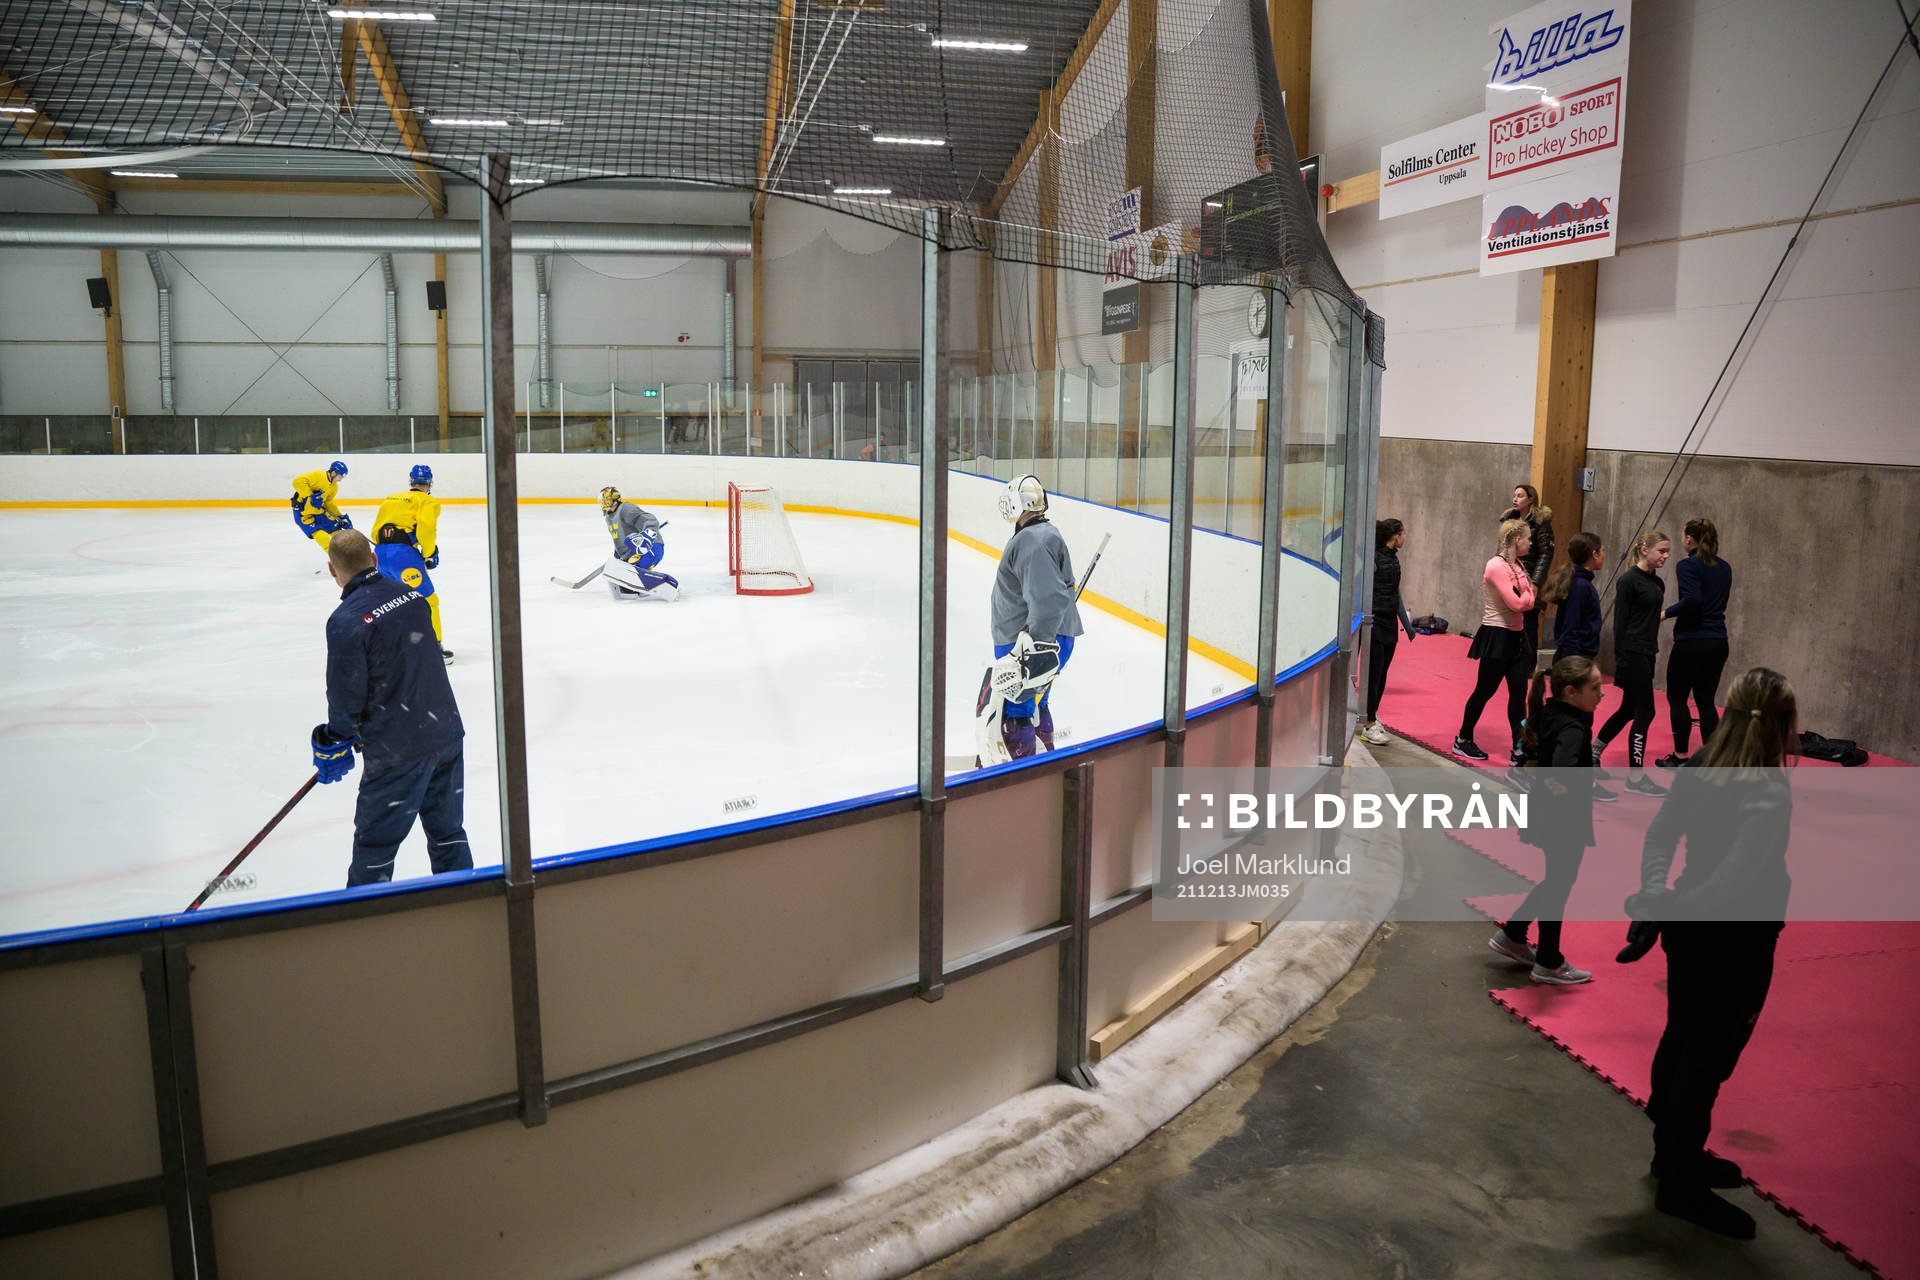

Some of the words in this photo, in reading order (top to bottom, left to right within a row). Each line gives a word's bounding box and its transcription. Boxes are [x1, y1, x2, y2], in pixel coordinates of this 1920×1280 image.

[1494, 106, 1565, 144] NOBO
[1570, 92, 1614, 116] SPORT
[1388, 156, 1433, 180] Solfilms
[1435, 142, 1476, 165] Center
[1495, 152, 1515, 168] Pro
[1519, 136, 1566, 161] Hockey
[1570, 125, 1608, 148] Shop
[1439, 168, 1467, 185] Uppsala
[1488, 197, 1611, 240] UPPLANDS
[1488, 219, 1609, 252] Ventilationstjänst
[1105, 246, 1136, 284] AVIS
[372, 595, 410, 618] SVENSKA
